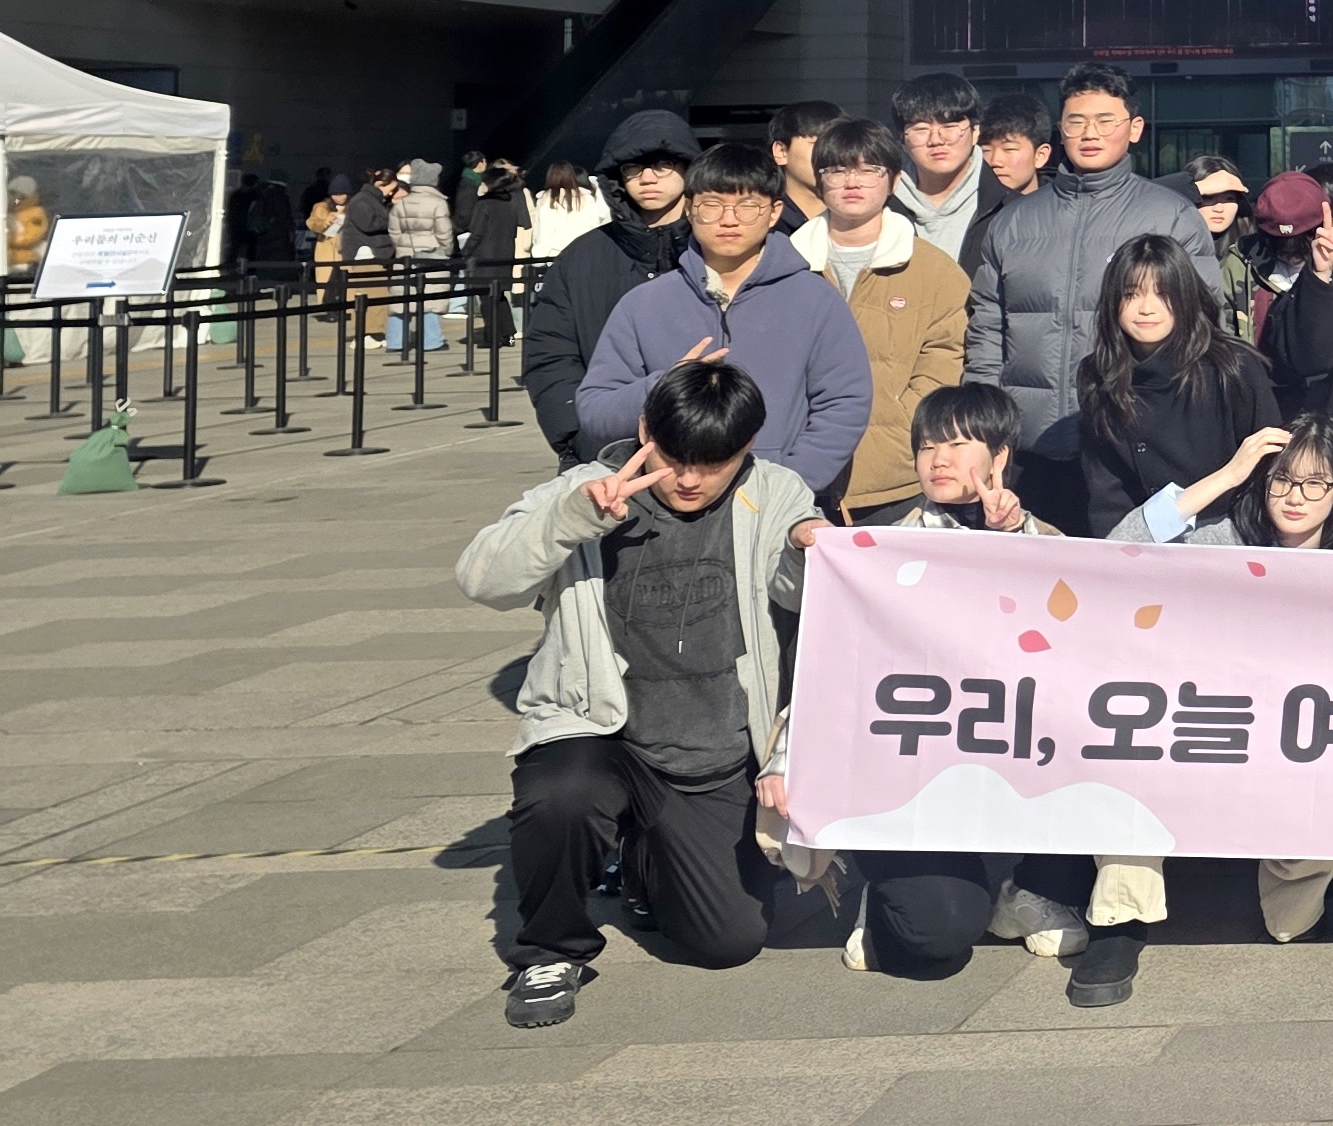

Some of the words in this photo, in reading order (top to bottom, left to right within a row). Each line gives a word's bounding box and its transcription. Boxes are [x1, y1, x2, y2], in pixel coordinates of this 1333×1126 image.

[72, 234, 118, 246] 우리들의
[123, 232, 157, 244] 이순신
[869, 673, 1056, 767] 우리,
[1080, 681, 1255, 764] 오늘
